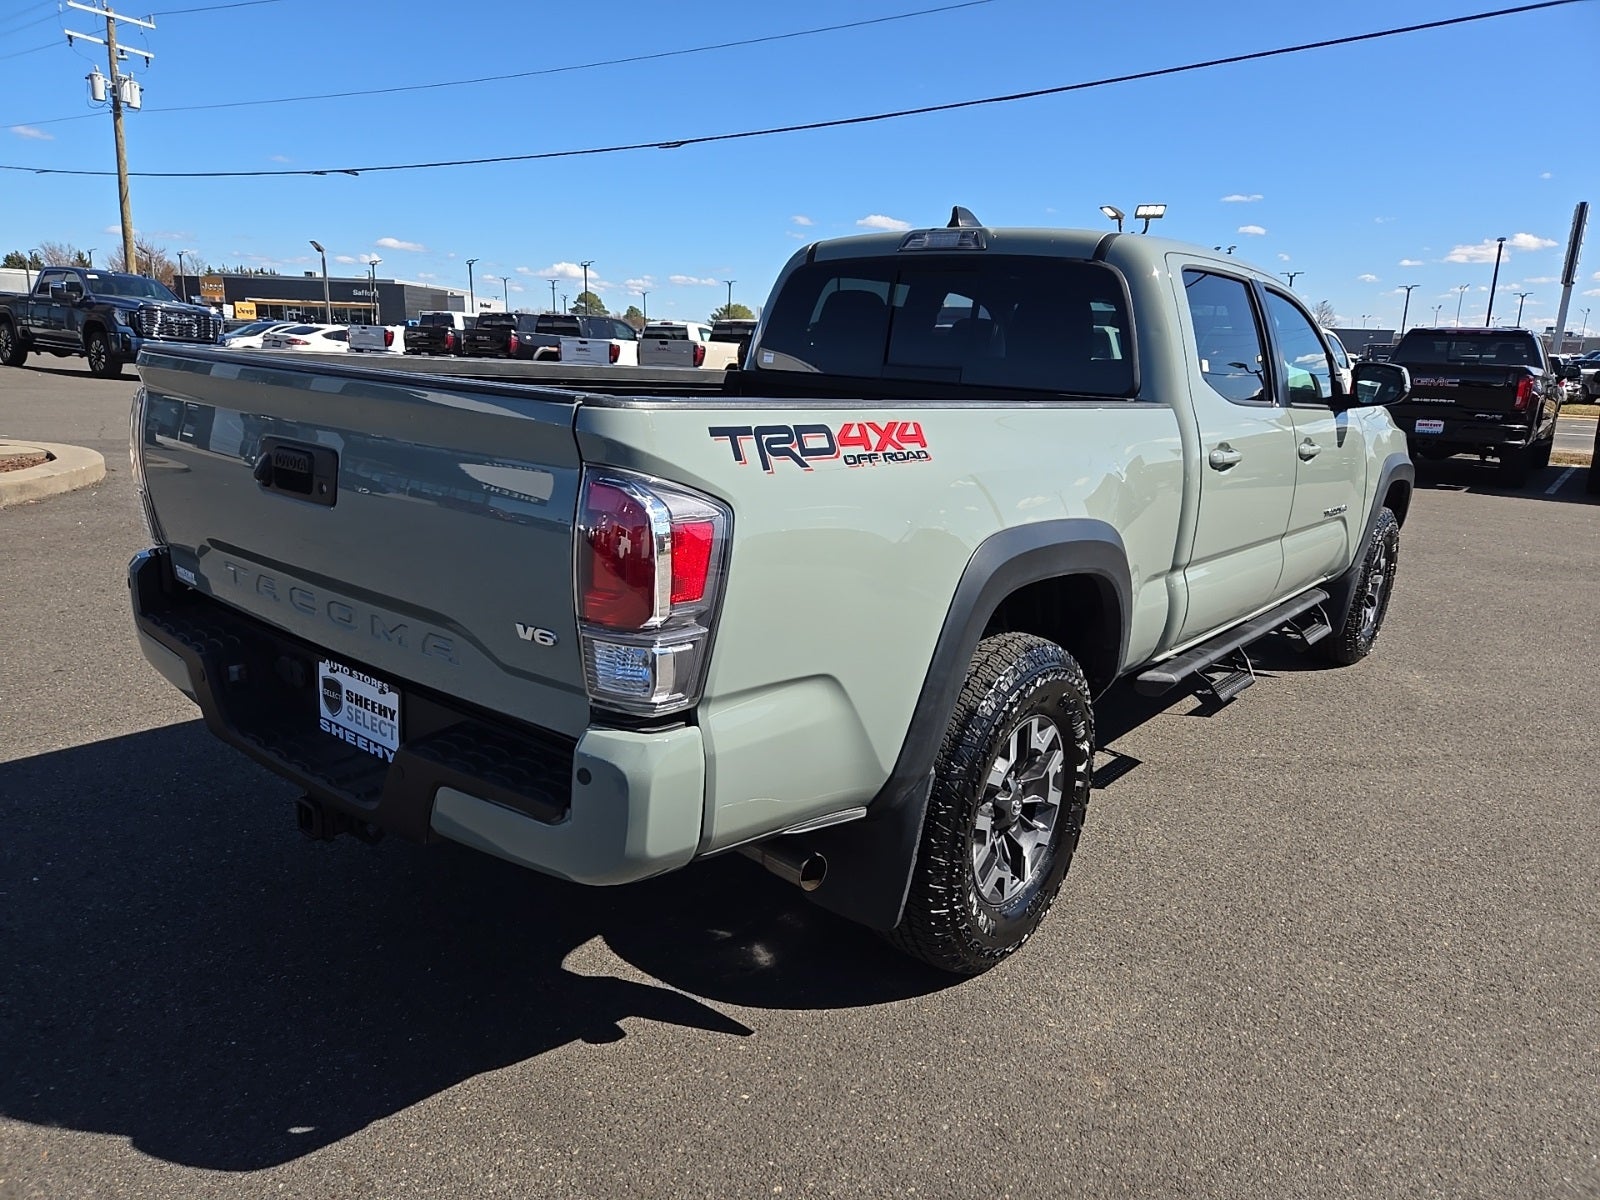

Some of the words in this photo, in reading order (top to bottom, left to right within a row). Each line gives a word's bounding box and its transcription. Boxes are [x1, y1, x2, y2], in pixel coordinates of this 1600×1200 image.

[201, 281, 223, 292] Jeep
[1413, 377, 1460, 387] GMC
[708, 424, 841, 474] TRD
[843, 453, 881, 468] OFF
[882, 449, 932, 466] ROAD
[223, 561, 460, 665] TACOMA
[515, 622, 558, 647] V6
[324, 658, 350, 675] AUTO
[352, 669, 389, 692] STORES
[323, 688, 342, 700] SELECT
[345, 689, 397, 721] SHEEHY
[346, 704, 397, 741] SELECT
[319, 718, 395, 763] SHEEHY
